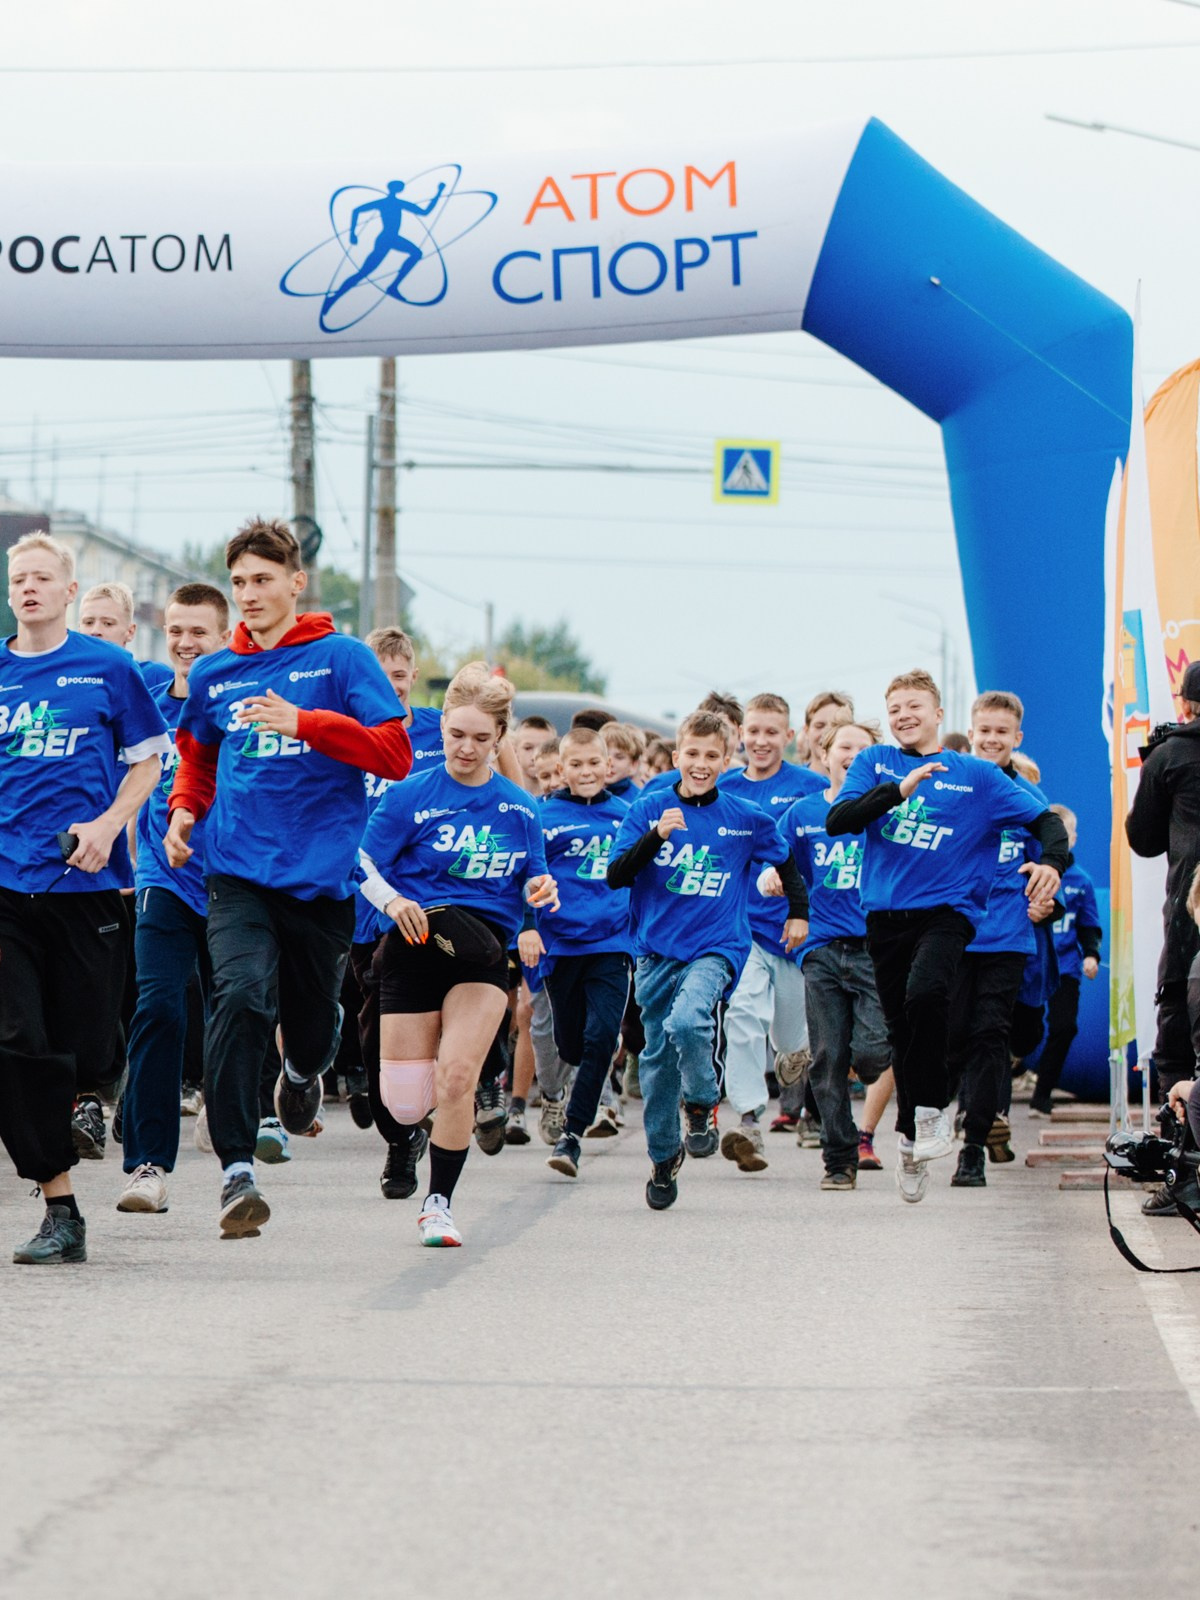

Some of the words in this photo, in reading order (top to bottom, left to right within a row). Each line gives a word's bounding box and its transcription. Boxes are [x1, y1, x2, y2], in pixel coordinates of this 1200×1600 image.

[523, 161, 737, 225] АТОМ
[492, 231, 758, 305] СПОРТ
[67, 677, 103, 685] РОСАТОМ
[20, 727, 89, 757] БЕГ
[943, 783, 973, 792] РОСАТОМ
[432, 824, 491, 852] ЗА!
[892, 819, 954, 851] БЕГ
[464, 851, 527, 879] БЕГ
[653, 840, 710, 871] ЗА!
[814, 841, 859, 866] ЗА!
[998, 841, 1025, 863] ЕГ
[679, 871, 731, 898] БЕГ
